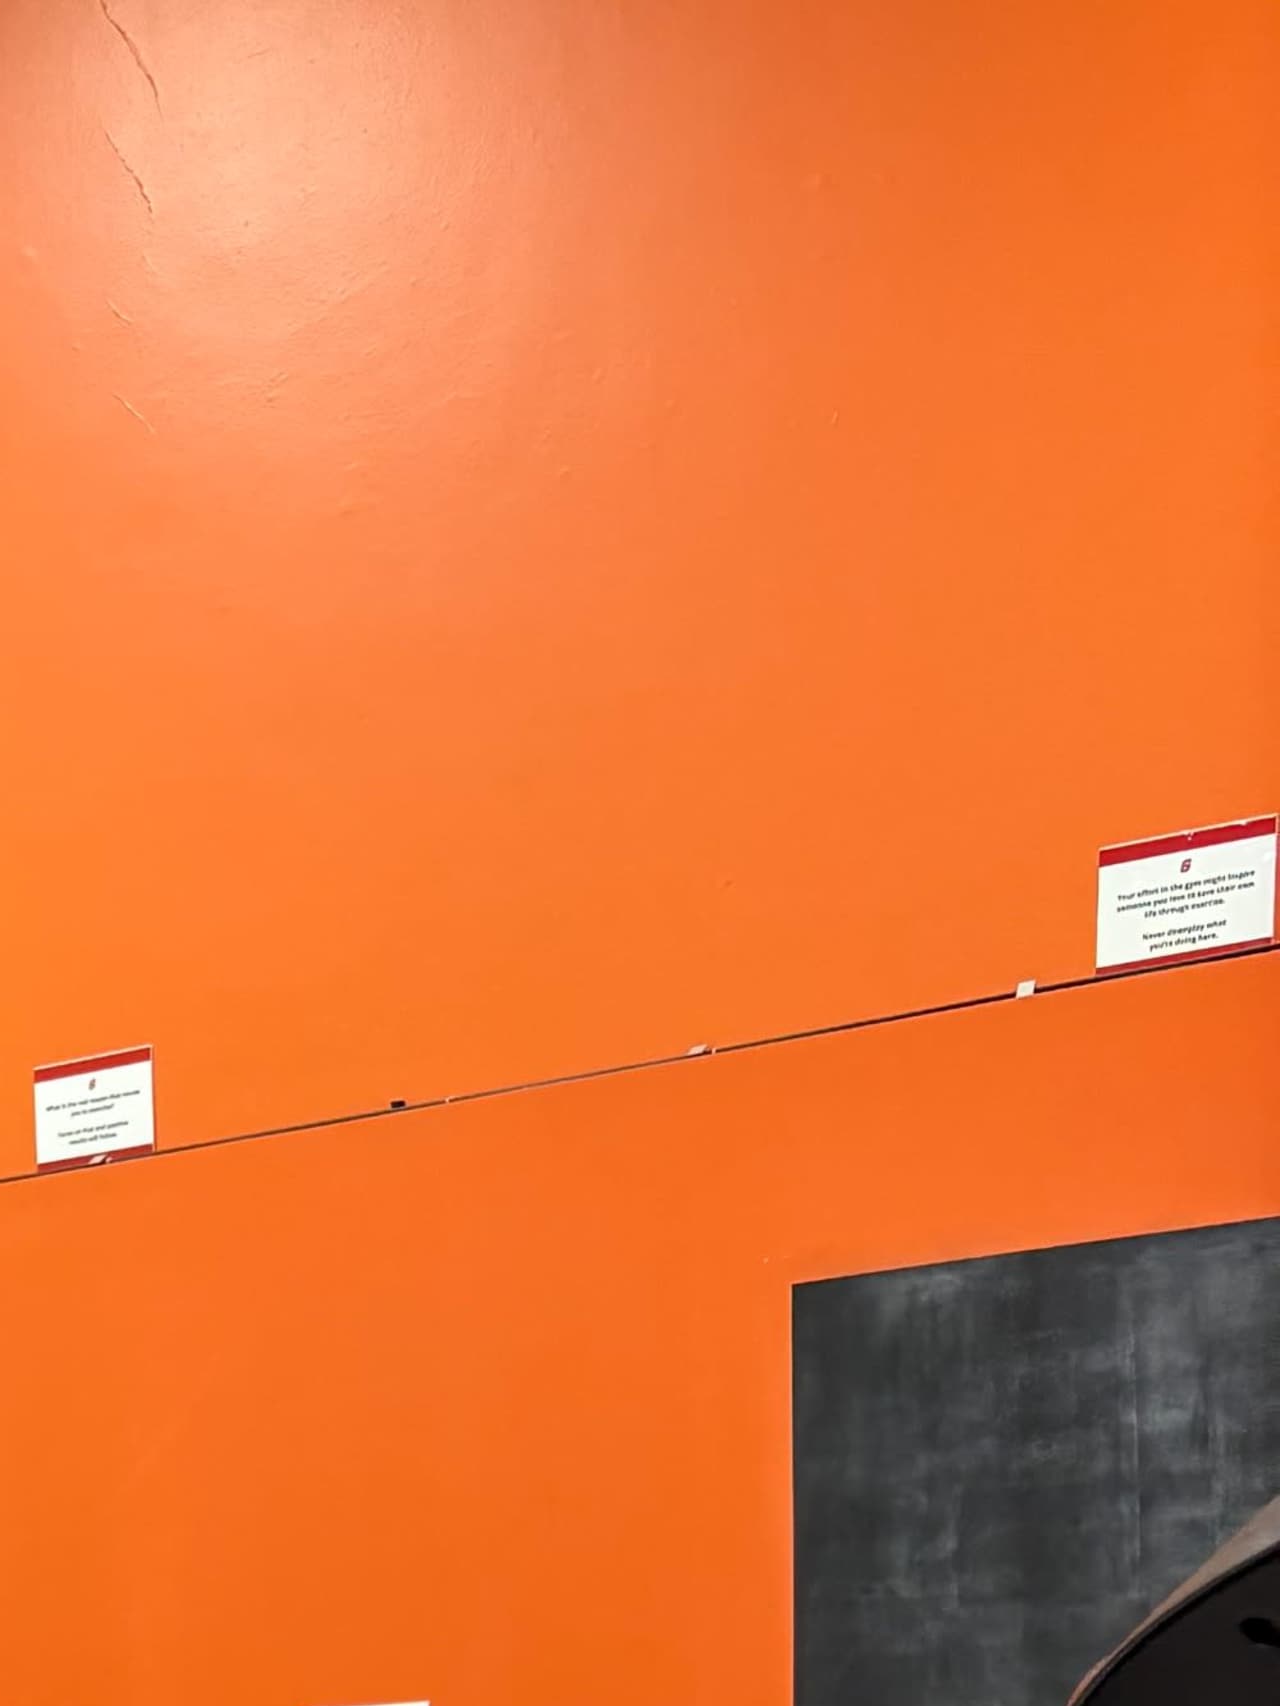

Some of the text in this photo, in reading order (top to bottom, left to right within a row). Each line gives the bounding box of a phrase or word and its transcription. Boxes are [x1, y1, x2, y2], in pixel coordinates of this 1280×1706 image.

[1137, 889, 1159, 898] effort
[1185, 881, 1201, 891] gym
[1203, 876, 1226, 886] might
[1227, 870, 1256, 882] inspire
[1117, 901, 1151, 913] someone
[1153, 898, 1168, 907] you
[1216, 886, 1236, 894] their
[1237, 881, 1255, 889] own
[1158, 904, 1189, 916] through
[1143, 931, 1165, 941] Never
[1206, 920, 1227, 930] what
[1174, 936, 1197, 946] doing
